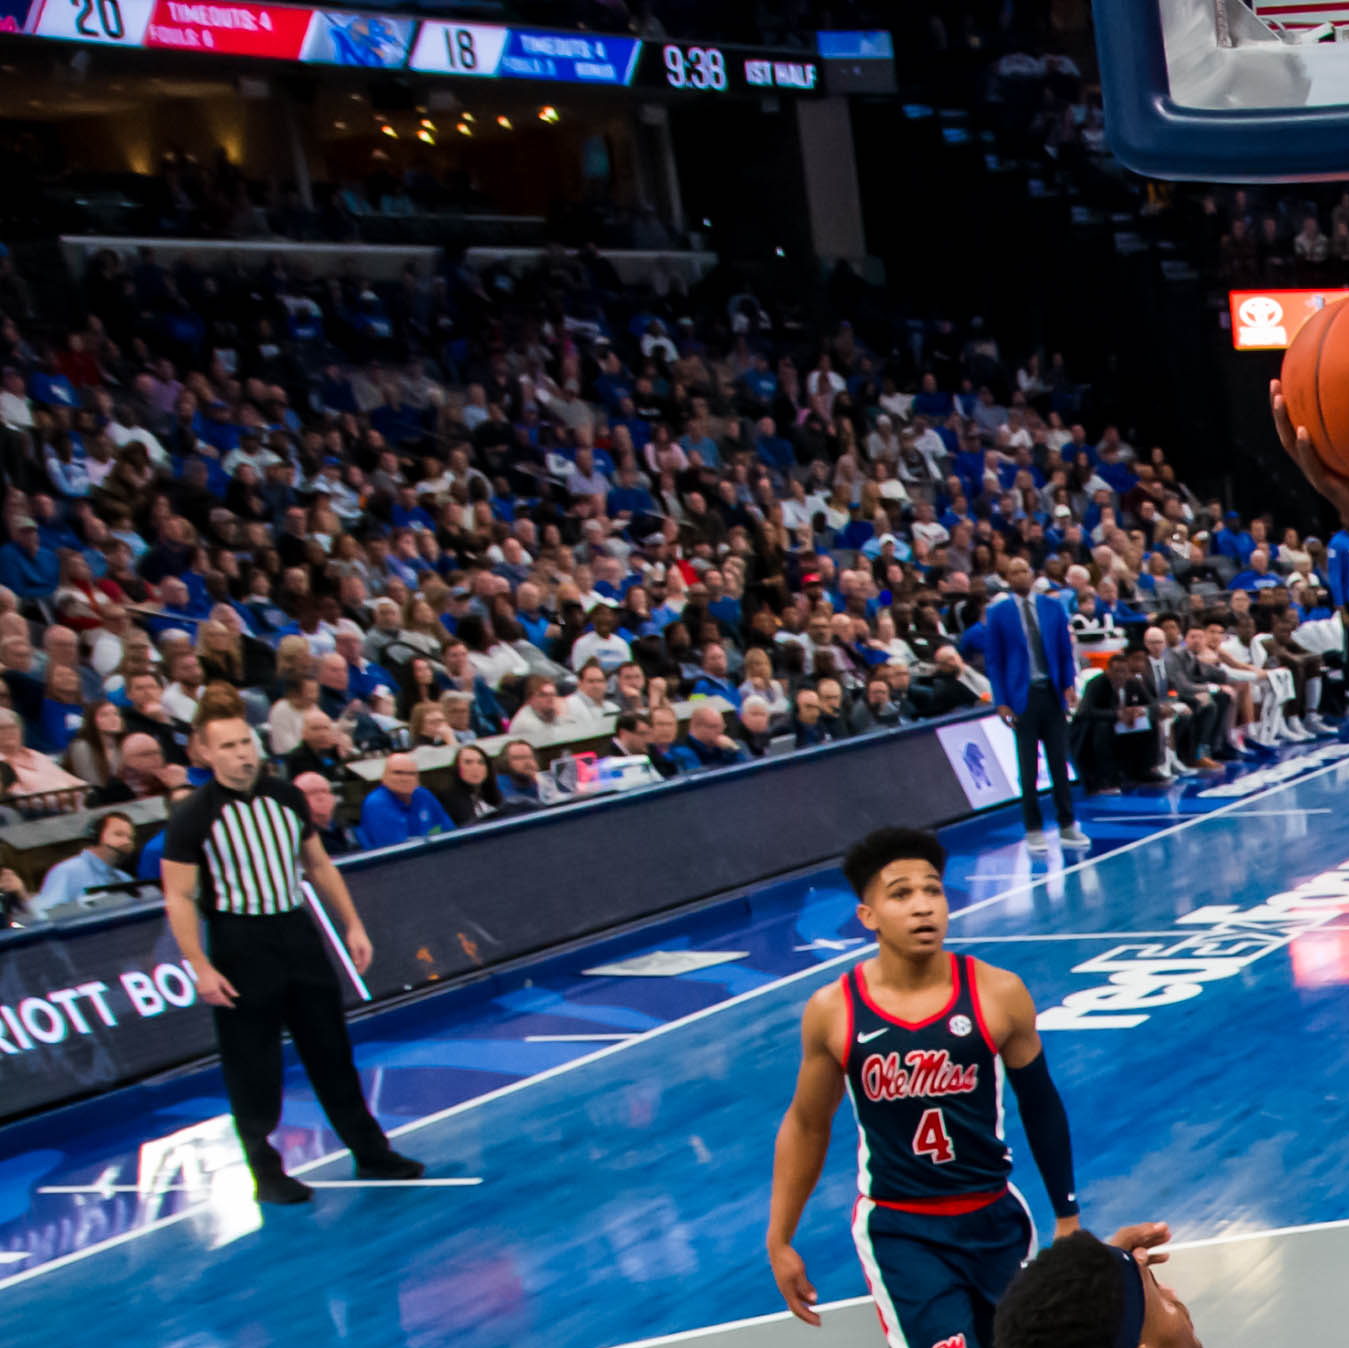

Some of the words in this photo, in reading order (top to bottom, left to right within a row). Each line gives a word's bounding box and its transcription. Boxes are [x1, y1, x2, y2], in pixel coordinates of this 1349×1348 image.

[70, 0, 124, 39] 20
[444, 28, 476, 69] 18
[664, 44, 728, 91] 9:38
[862, 1051, 908, 1101] Ole
[905, 1049, 978, 1097] Miss
[912, 1107, 956, 1164] 4
